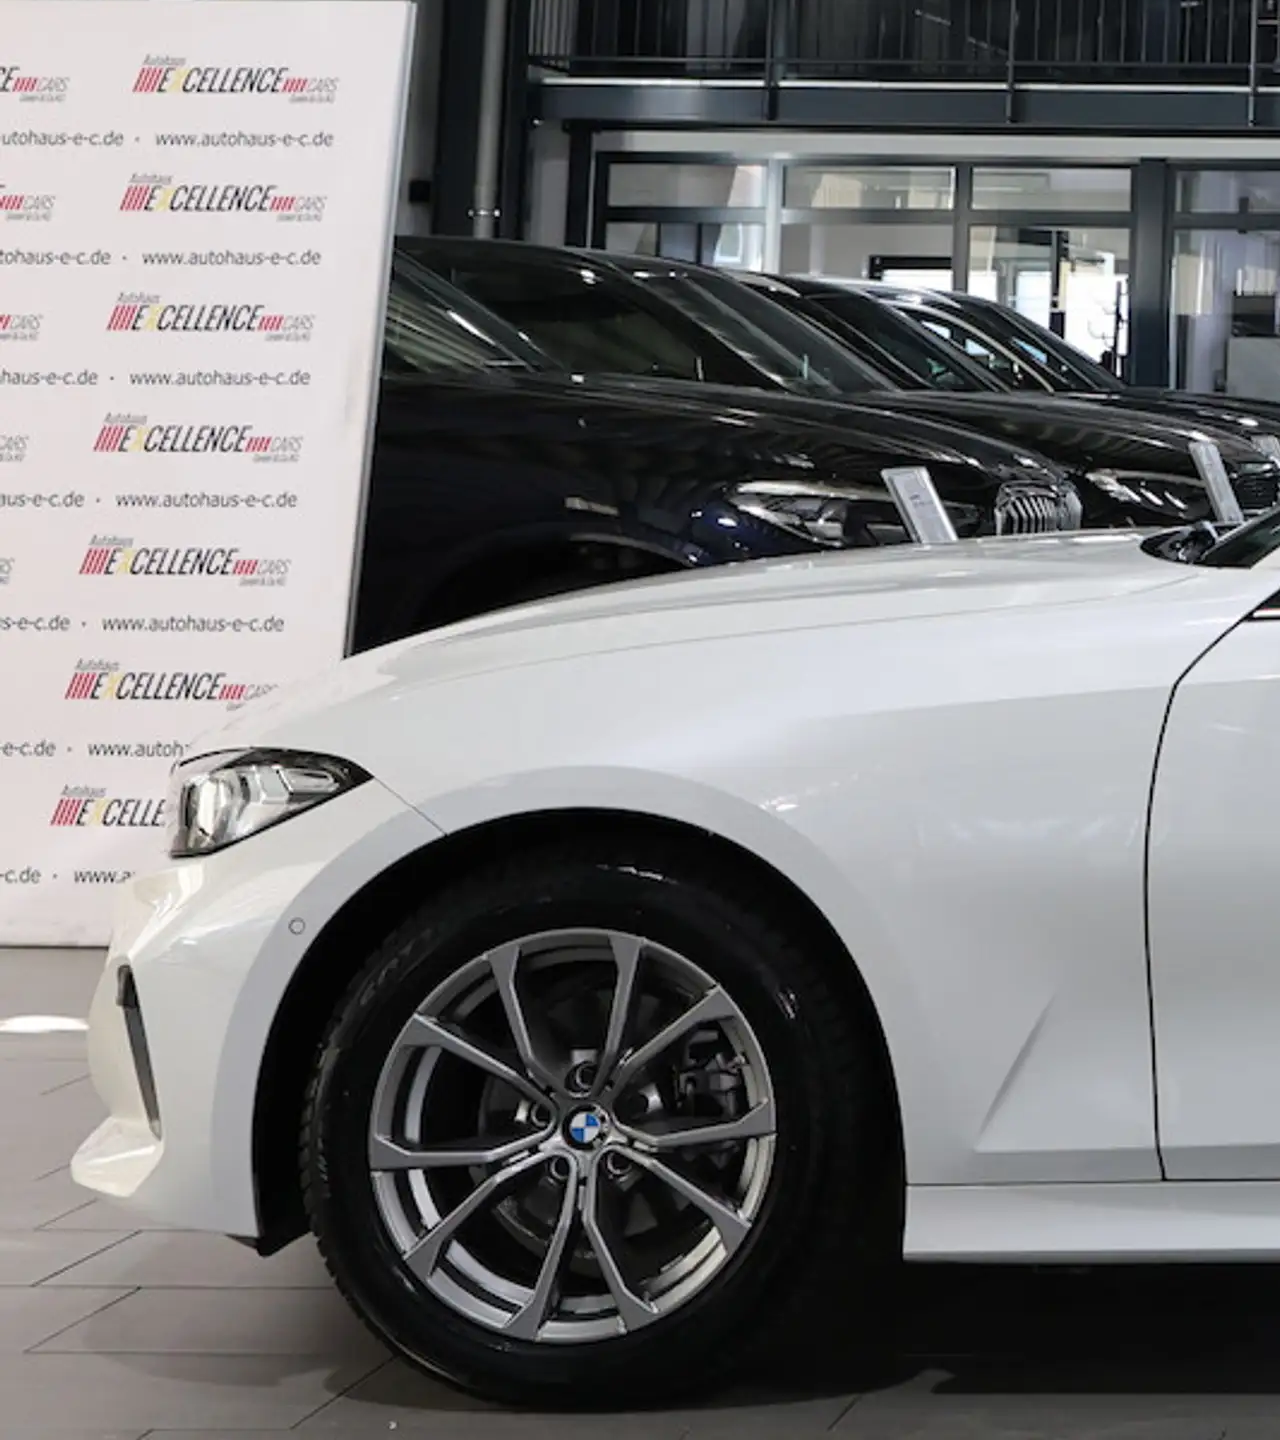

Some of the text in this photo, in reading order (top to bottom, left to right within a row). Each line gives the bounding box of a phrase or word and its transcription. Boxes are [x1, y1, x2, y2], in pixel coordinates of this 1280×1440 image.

[156, 66, 288, 94] EXCELLENCE
[0, 129, 334, 147] utohaus-e-c.de www.autohaus-e-c.de
[143, 185, 277, 212] EXCELLENCE
[141, 249, 322, 266] www.autohaus-e-c.de
[131, 304, 264, 331] EXCELLENCE
[0, 368, 311, 387] haus-e-c.de www.autohaus-e-c.de
[118, 425, 252, 453] EXCELLENCE
[115, 491, 298, 509] www.autohaus-e-c.de
[104, 547, 238, 575] EXCELLENCE
[101, 614, 285, 633] www.autohaus-e-c.de
[90, 671, 226, 700] EXCELLENCE
[76, 798, 166, 827] EXCELLE
